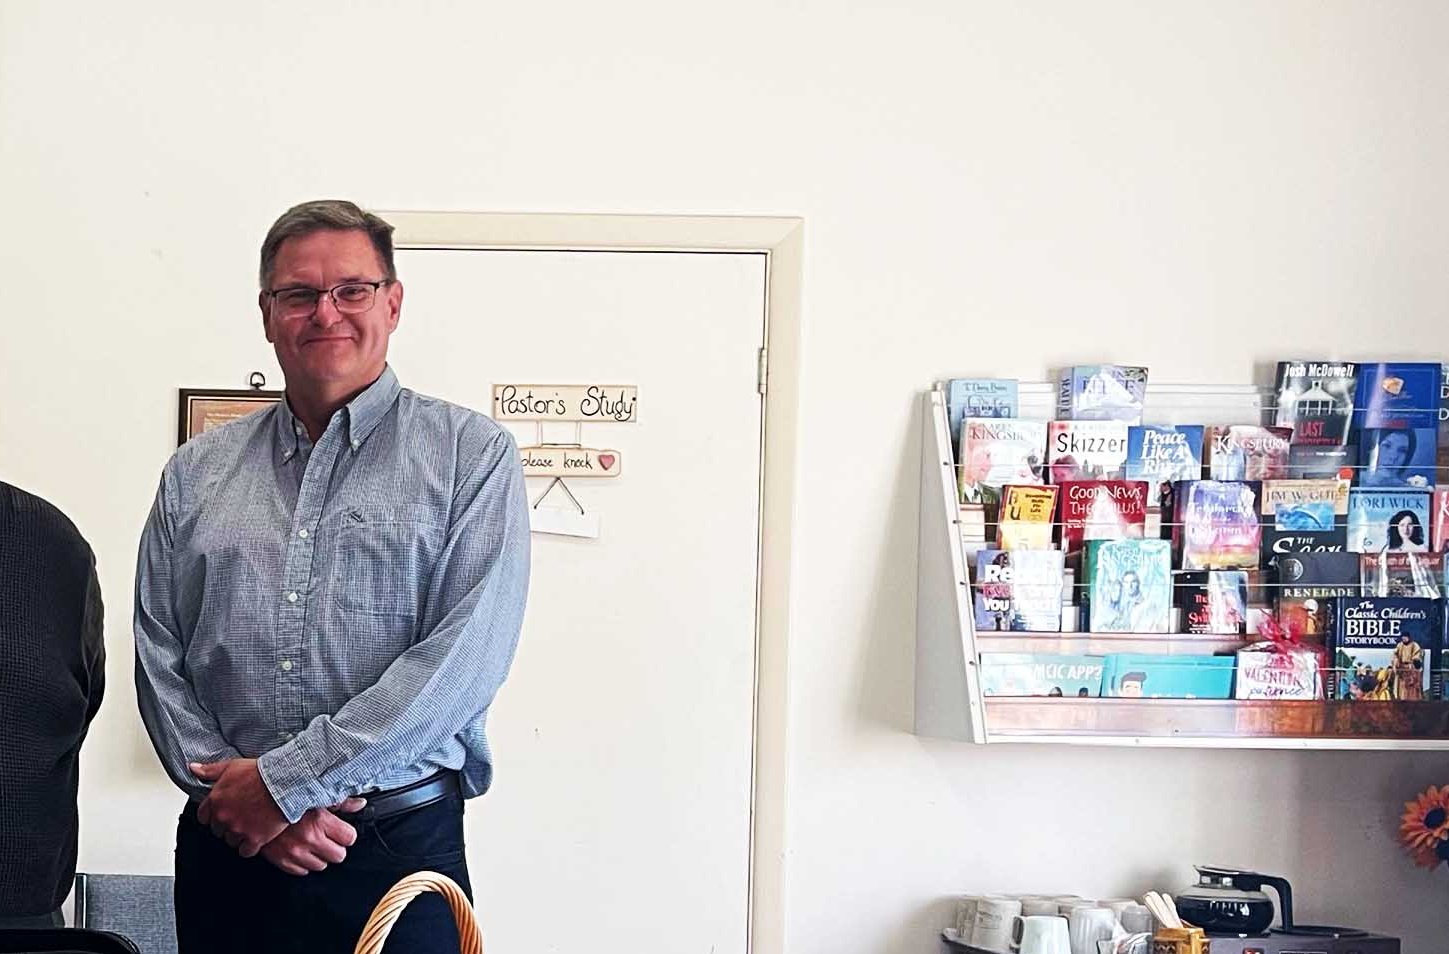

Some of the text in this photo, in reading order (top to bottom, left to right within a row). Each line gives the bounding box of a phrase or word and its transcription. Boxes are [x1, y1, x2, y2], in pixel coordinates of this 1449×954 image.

[1285, 364, 1354, 377] Josh McDowell
[501, 385, 633, 422] Pastor's Study
[1299, 421, 1324, 437] LAST
[1057, 432, 1126, 453] Skizzer
[1143, 430, 1186, 445] Peace
[1140, 445, 1185, 460] Like A
[1353, 496, 1424, 509] LORI WICK
[1284, 588, 1355, 597] RENEGADE
[983, 598, 1010, 612] YOU
[1359, 601, 1374, 609] The
[1345, 608, 1427, 620] Classic Children's
[1346, 619, 1401, 636] BIBLE
[1345, 637, 1397, 645] STORYBOOK
